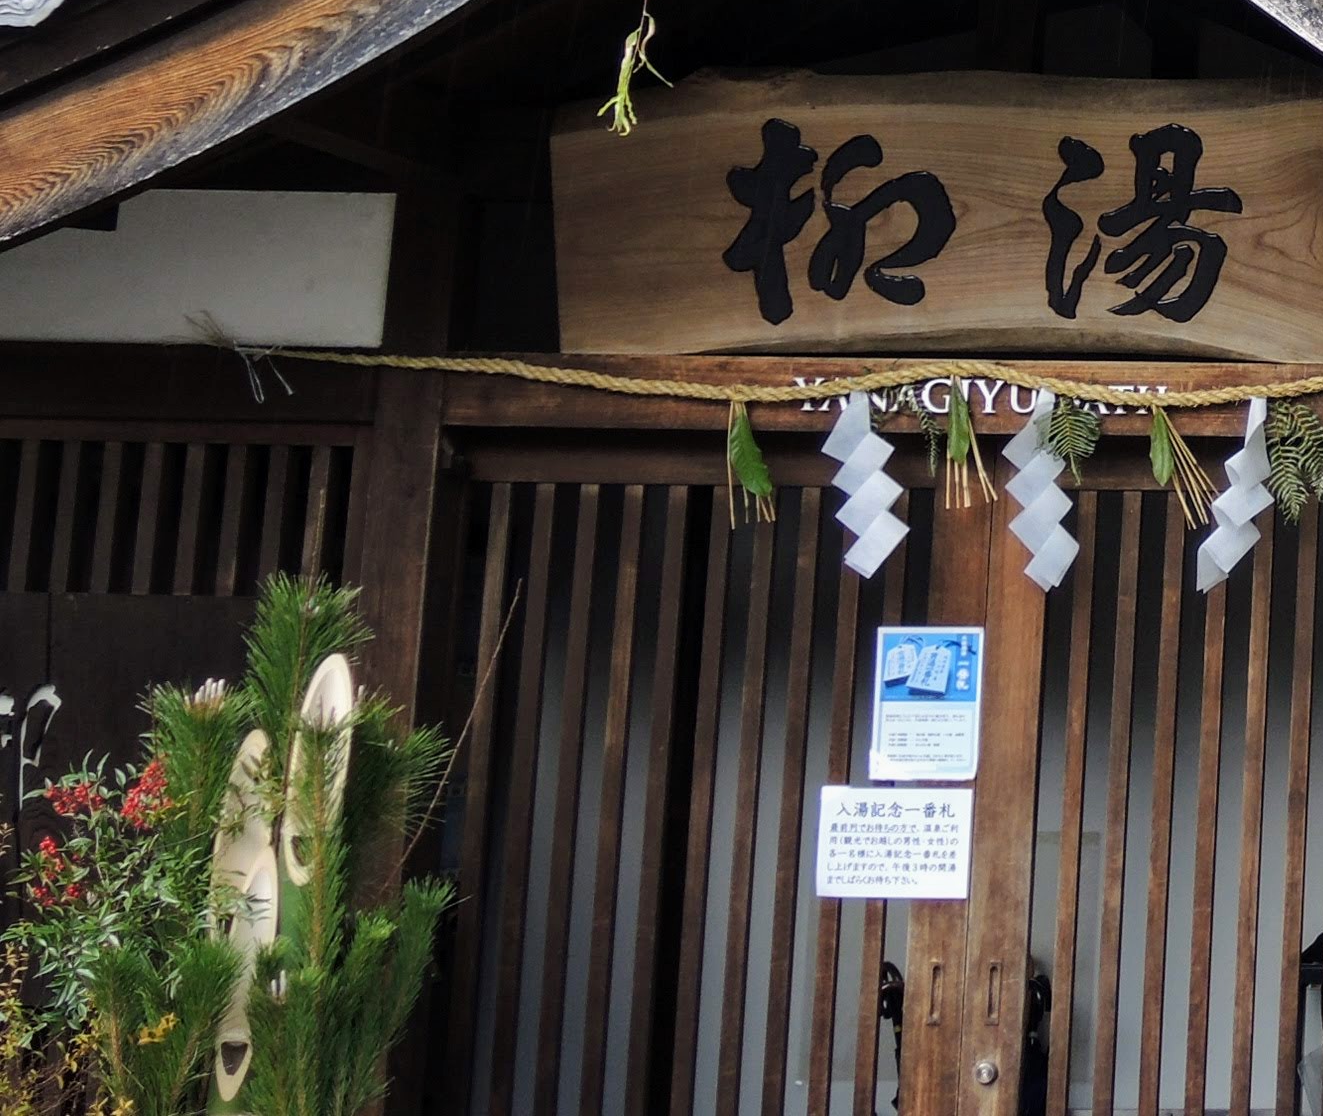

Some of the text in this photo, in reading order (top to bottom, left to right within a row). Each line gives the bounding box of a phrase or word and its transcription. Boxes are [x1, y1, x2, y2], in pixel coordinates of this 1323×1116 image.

[722, 116, 1243, 325] 柳湯
[836, 801, 956, 819] 入湯記念一番札
